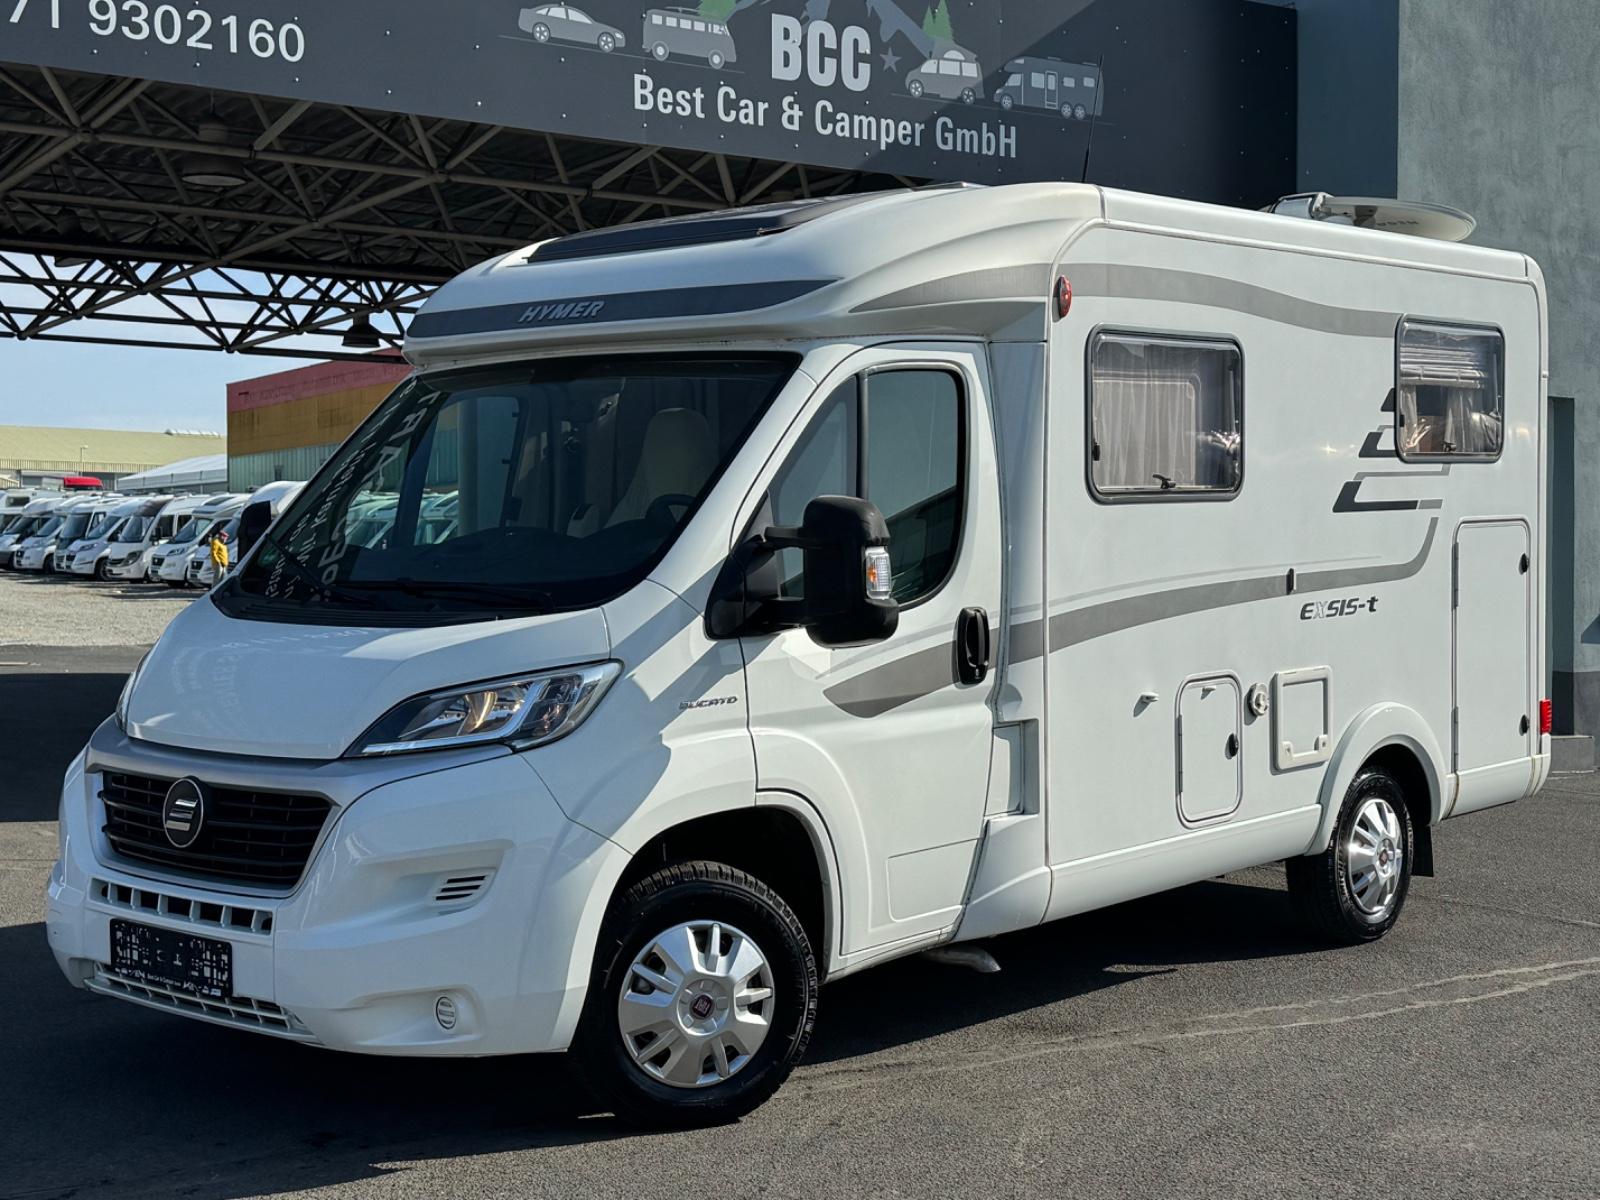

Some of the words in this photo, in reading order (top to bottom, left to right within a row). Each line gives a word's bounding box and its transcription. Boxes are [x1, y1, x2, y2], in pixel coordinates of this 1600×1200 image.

[88, 0, 305, 62] 9302160
[771, 13, 871, 92] BCC
[633, 73, 705, 118] Best
[717, 85, 769, 127] Car
[781, 95, 803, 131] &
[815, 100, 925, 150] Camper
[935, 116, 1017, 158] GmbH
[519, 300, 605, 323] HYMER
